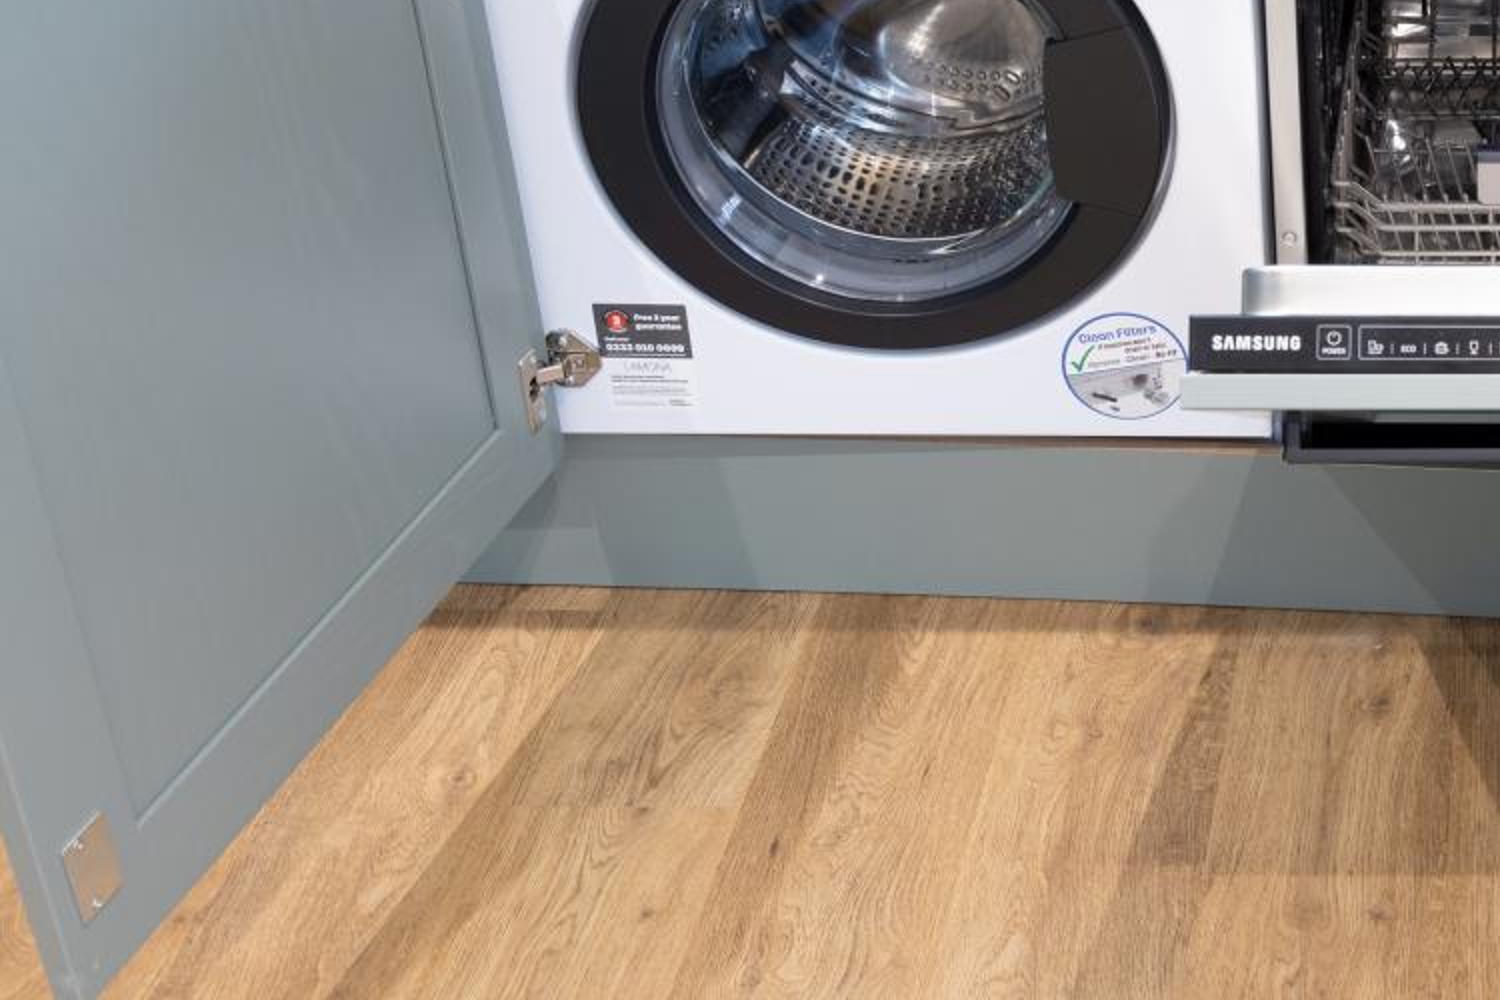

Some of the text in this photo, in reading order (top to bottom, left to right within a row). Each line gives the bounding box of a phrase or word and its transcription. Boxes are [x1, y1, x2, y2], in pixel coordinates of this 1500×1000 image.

[1078, 331, 1115, 344] Clean
[1115, 326, 1157, 339] Filters
[1211, 335, 1302, 351] SAMSUNG
